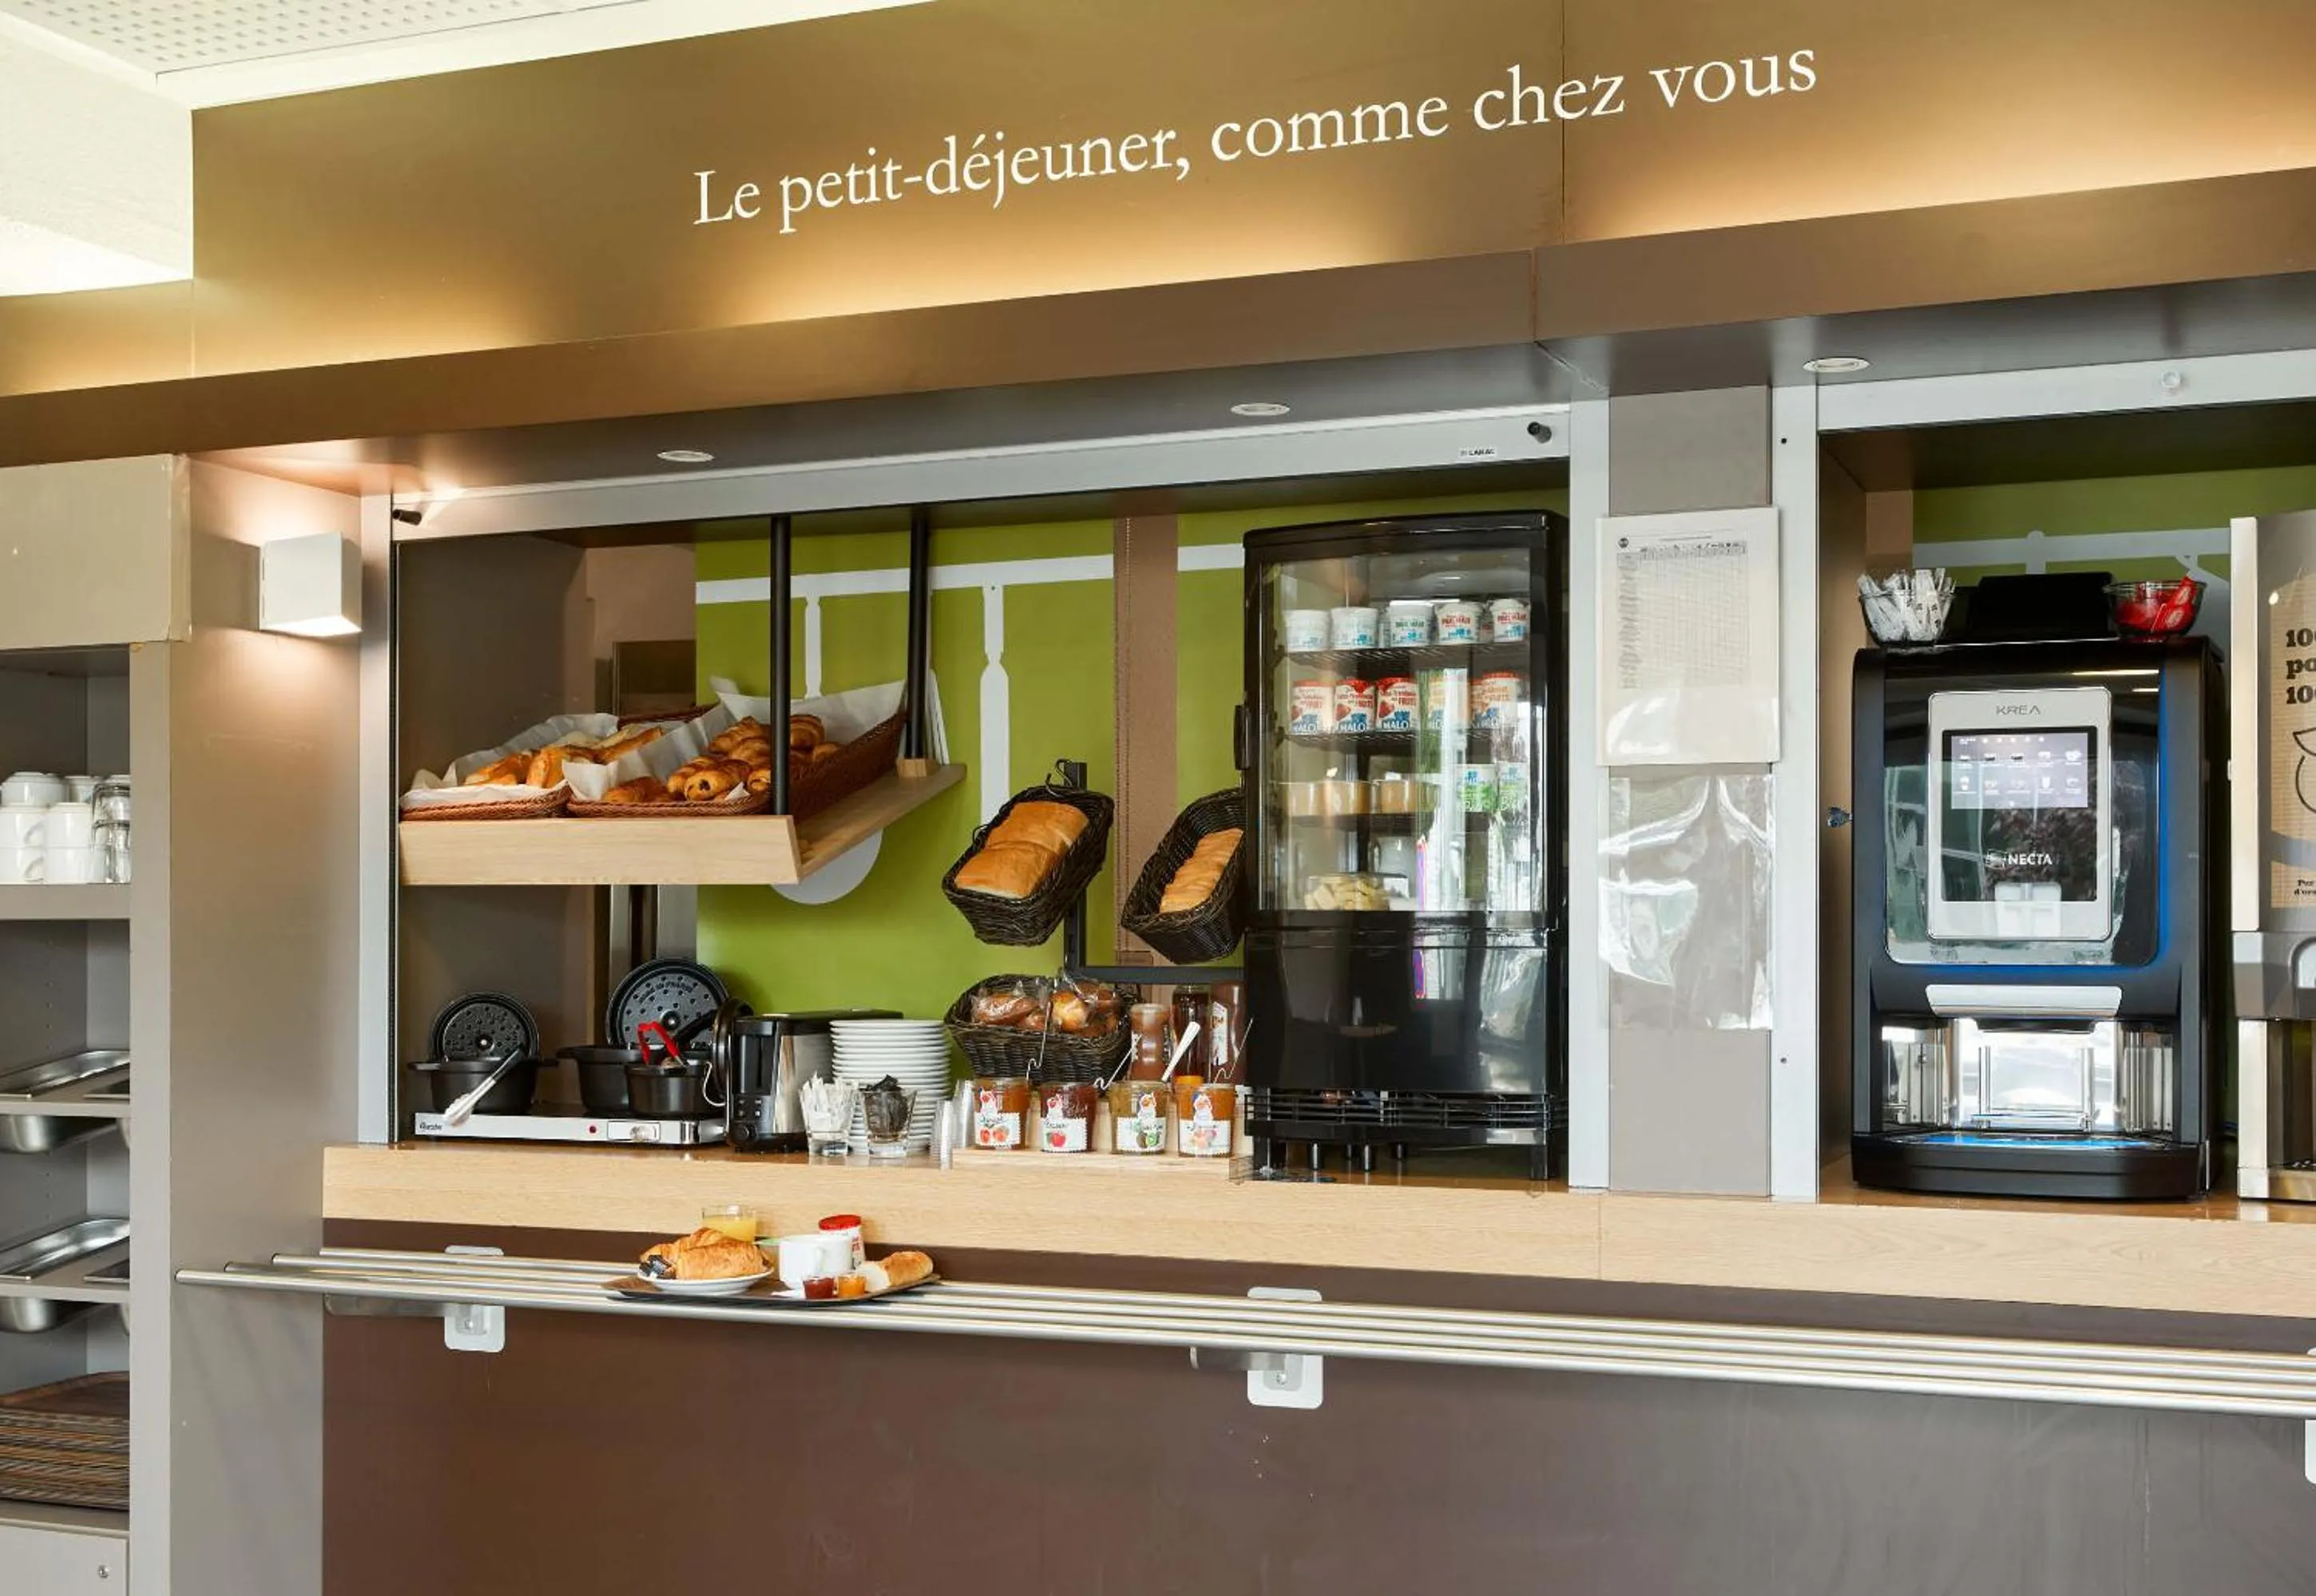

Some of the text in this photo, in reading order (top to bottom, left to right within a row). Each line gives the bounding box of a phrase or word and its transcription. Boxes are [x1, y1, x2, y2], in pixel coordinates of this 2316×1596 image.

[693, 50, 1817, 234] Le petit-déjeuner, comme chez vous
[2286, 628, 2316, 648] 10
[2286, 685, 2316, 704] 10
[1996, 704, 2041, 715] KREA
[2008, 853, 2053, 865] NECTA
